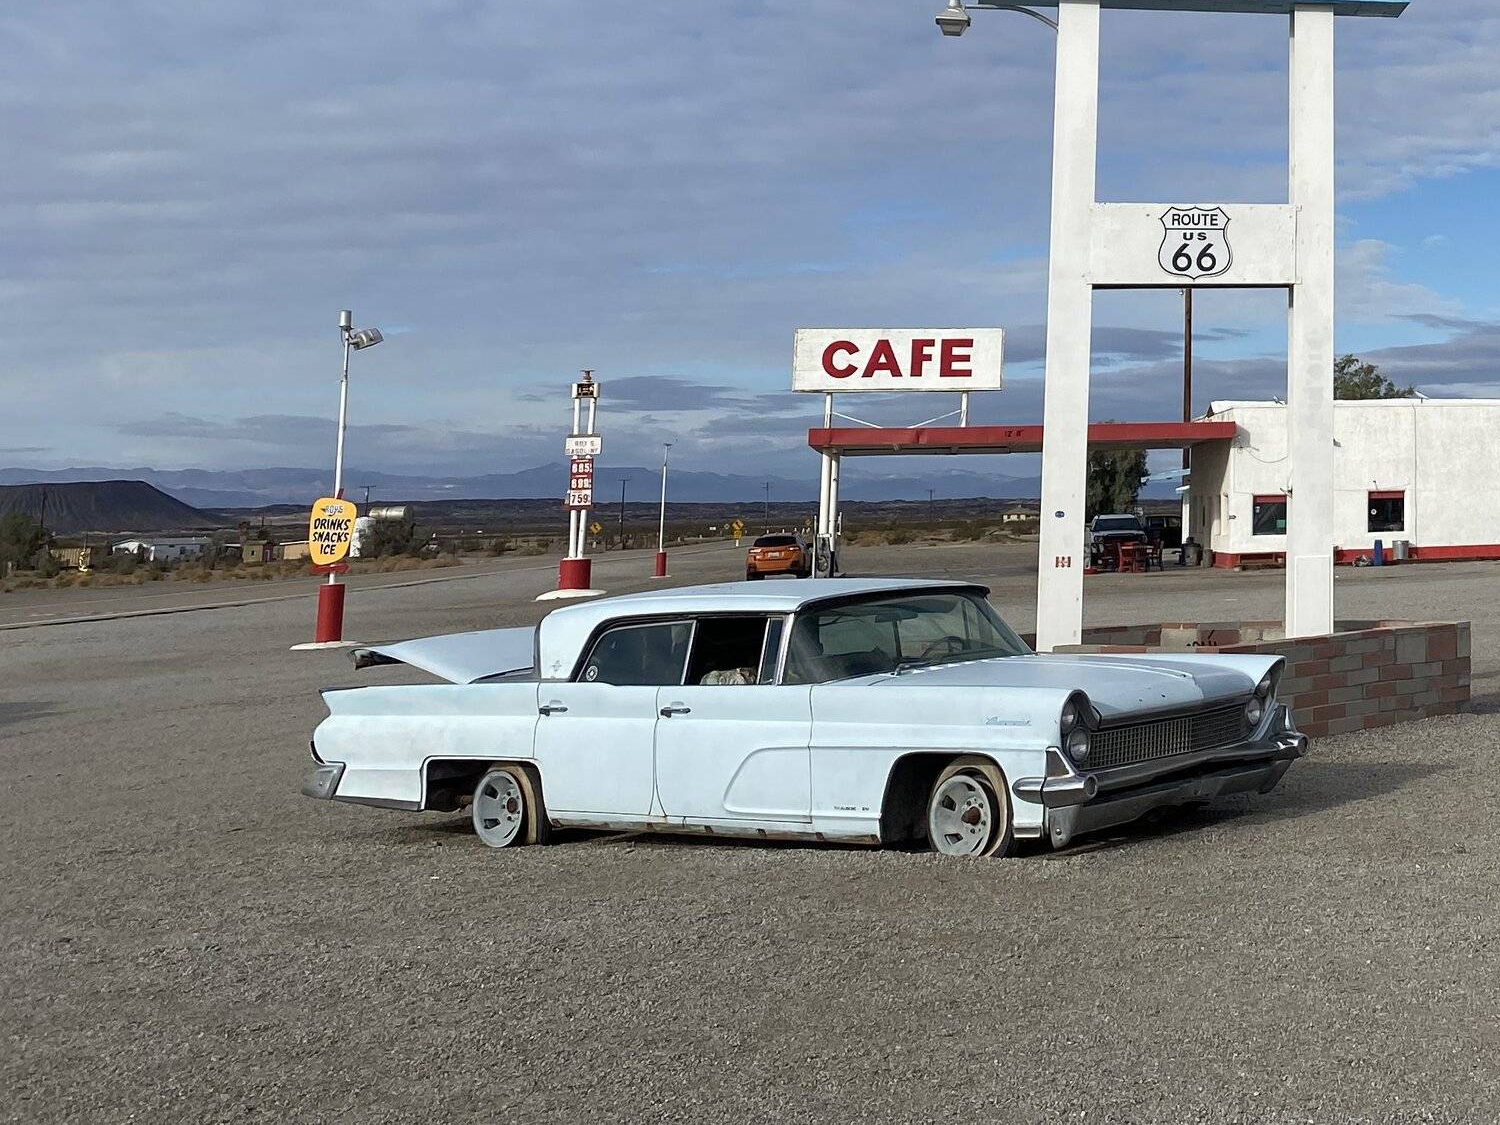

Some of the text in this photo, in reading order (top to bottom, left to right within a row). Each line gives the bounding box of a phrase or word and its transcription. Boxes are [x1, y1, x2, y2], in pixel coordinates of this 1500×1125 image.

[1171, 213, 1219, 226] ROUTE
[1171, 242, 1217, 272] 66
[821, 338, 974, 379] CAFE
[571, 493, 589, 504] 759
[313, 517, 352, 531] DRINKS
[312, 531, 350, 543] SNACKS
[320, 543, 336, 555] ICE
